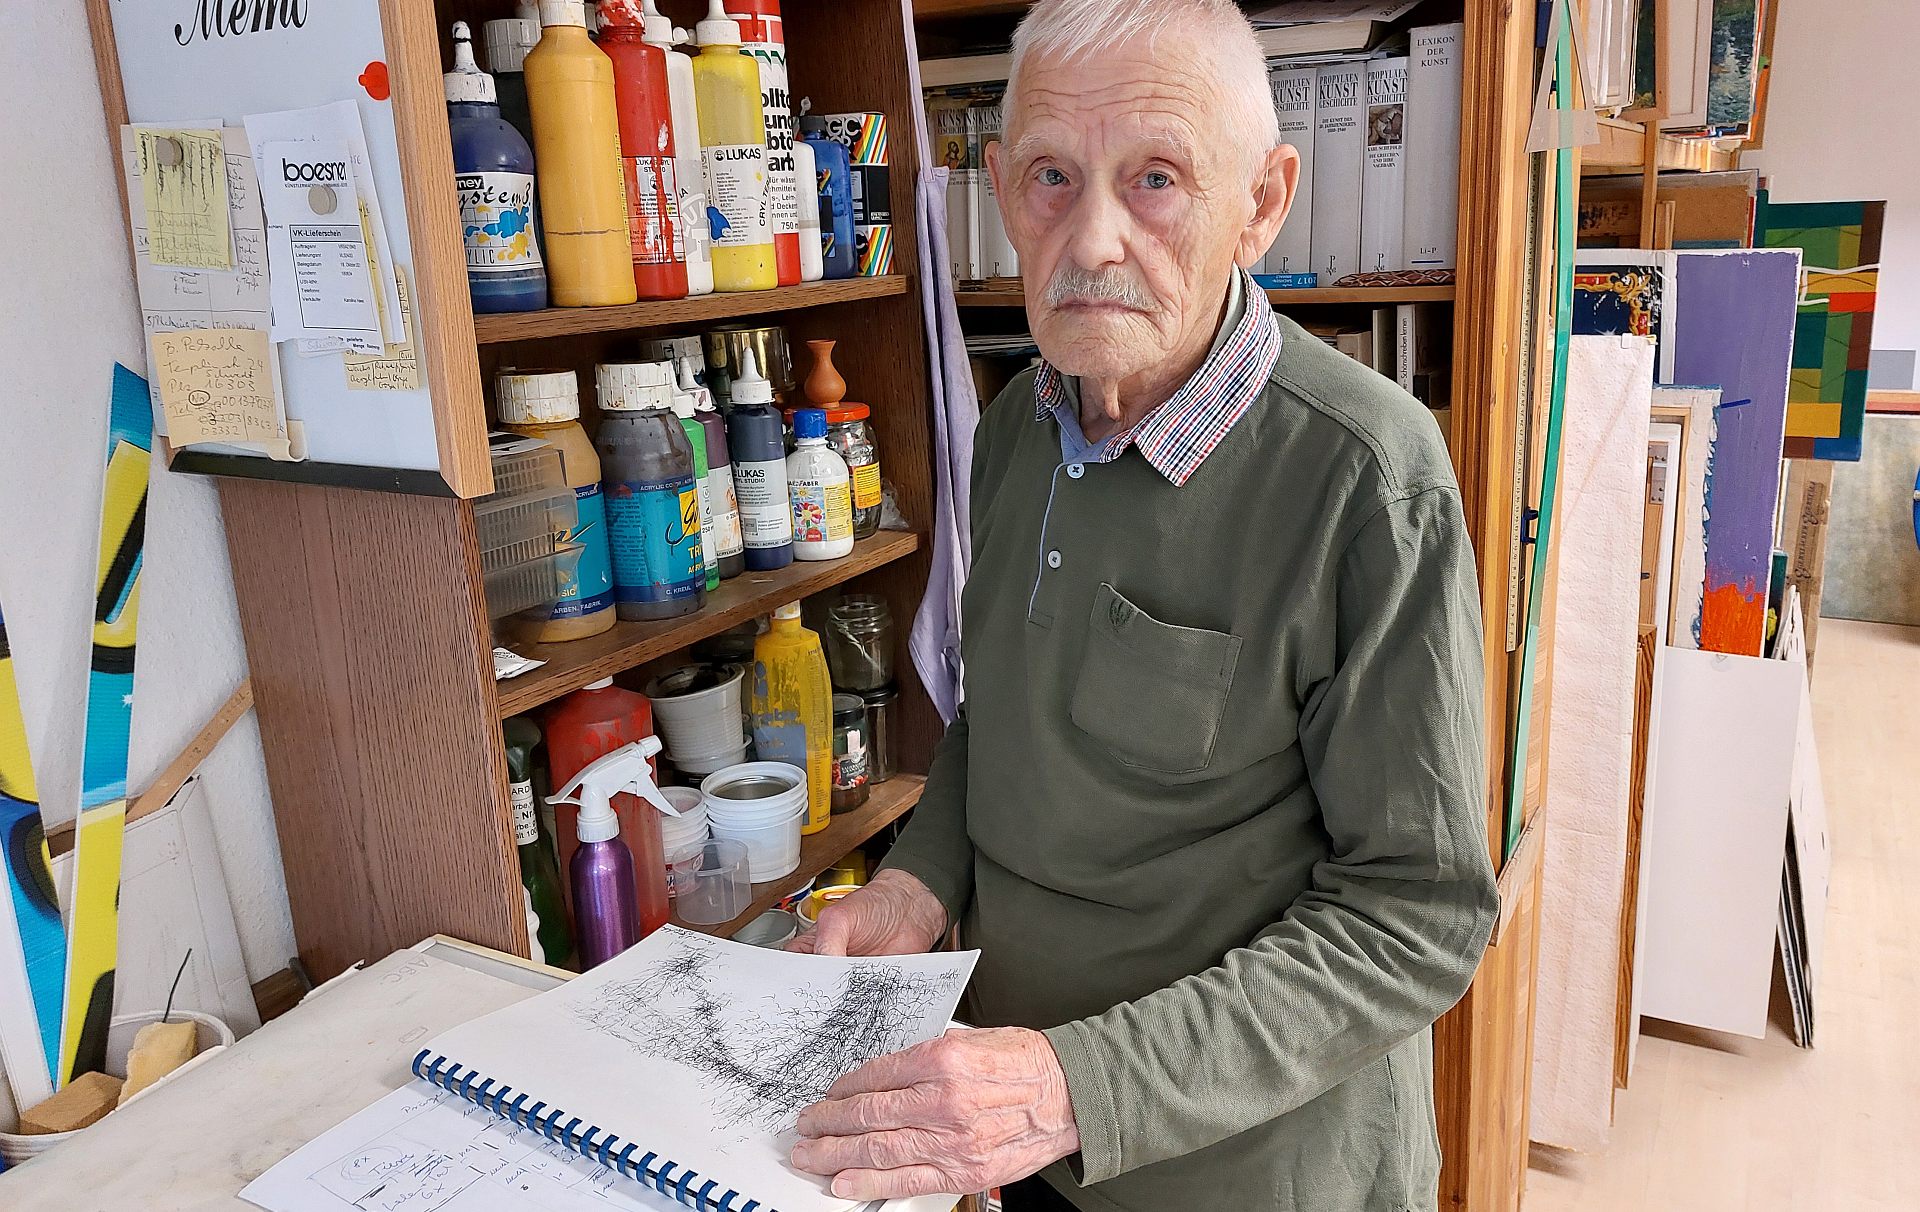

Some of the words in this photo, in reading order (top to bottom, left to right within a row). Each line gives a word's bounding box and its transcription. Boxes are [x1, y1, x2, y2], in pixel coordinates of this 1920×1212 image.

[174, 0, 308, 46] Memo
[1417, 36, 1455, 46] LEXIKON
[1427, 47, 1444, 56] DER
[1421, 57, 1449, 67] KUNST
[1319, 82, 1359, 99] KUNST
[1367, 77, 1408, 95] KUNST
[1273, 86, 1310, 103] KUNST
[978, 110, 1002, 125] KUNS
[725, 148, 762, 161] LUKAS
[759, 200, 767, 227] CRYL
[292, 229, 342, 238] VK-Lieferschein
[737, 469, 765, 478] LUKAS
